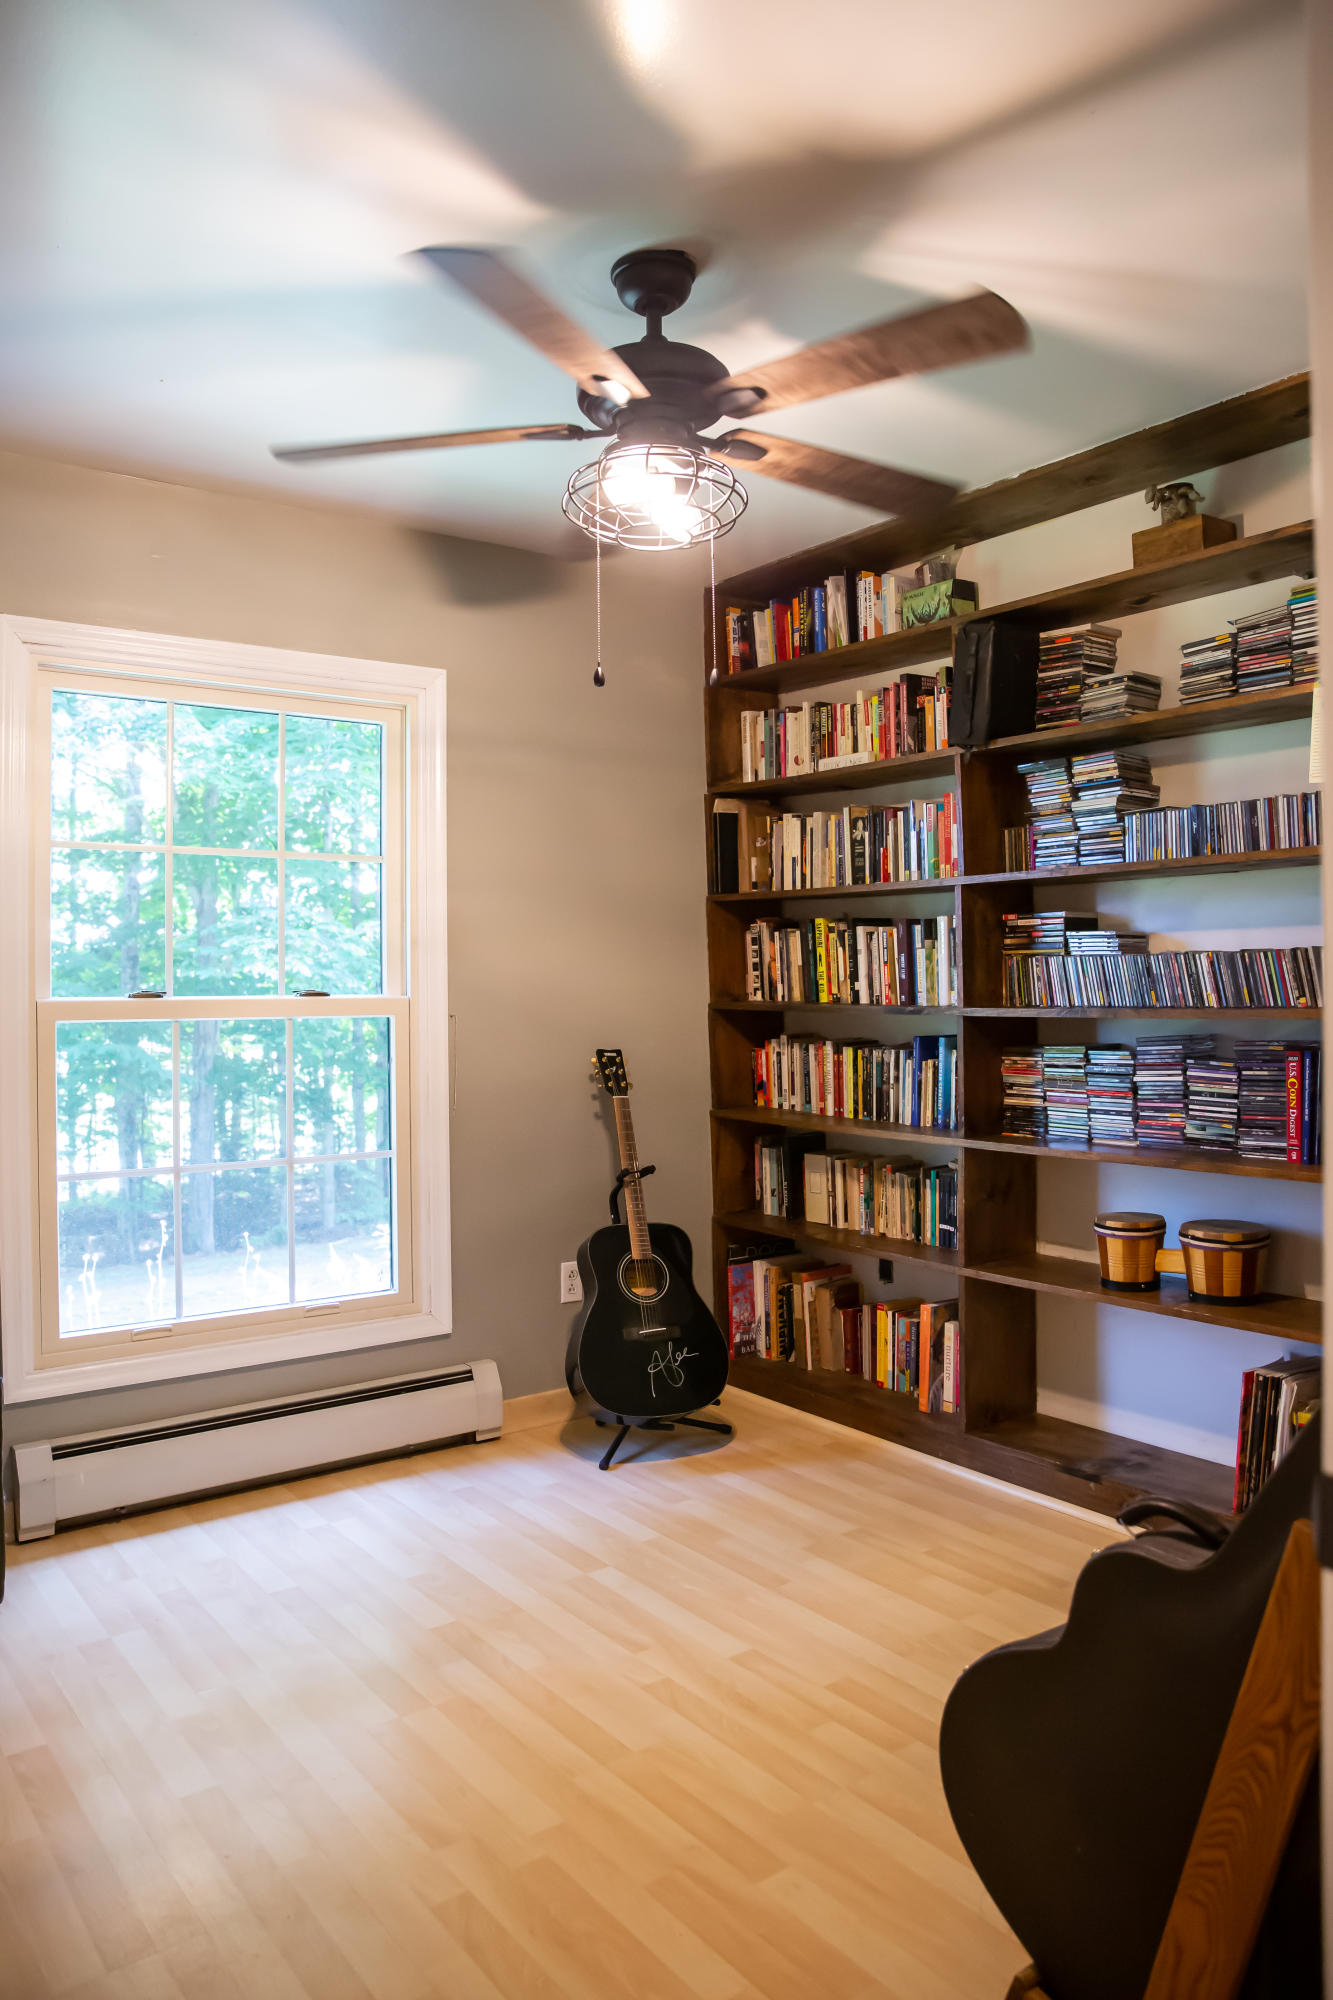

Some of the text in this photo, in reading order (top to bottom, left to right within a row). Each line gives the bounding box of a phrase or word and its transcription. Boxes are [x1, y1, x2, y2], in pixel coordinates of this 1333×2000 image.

[1289, 1062, 1297, 1077] U.S.
[1287, 1077, 1298, 1107] COIN
[1289, 1108, 1297, 1137] DIGEST
